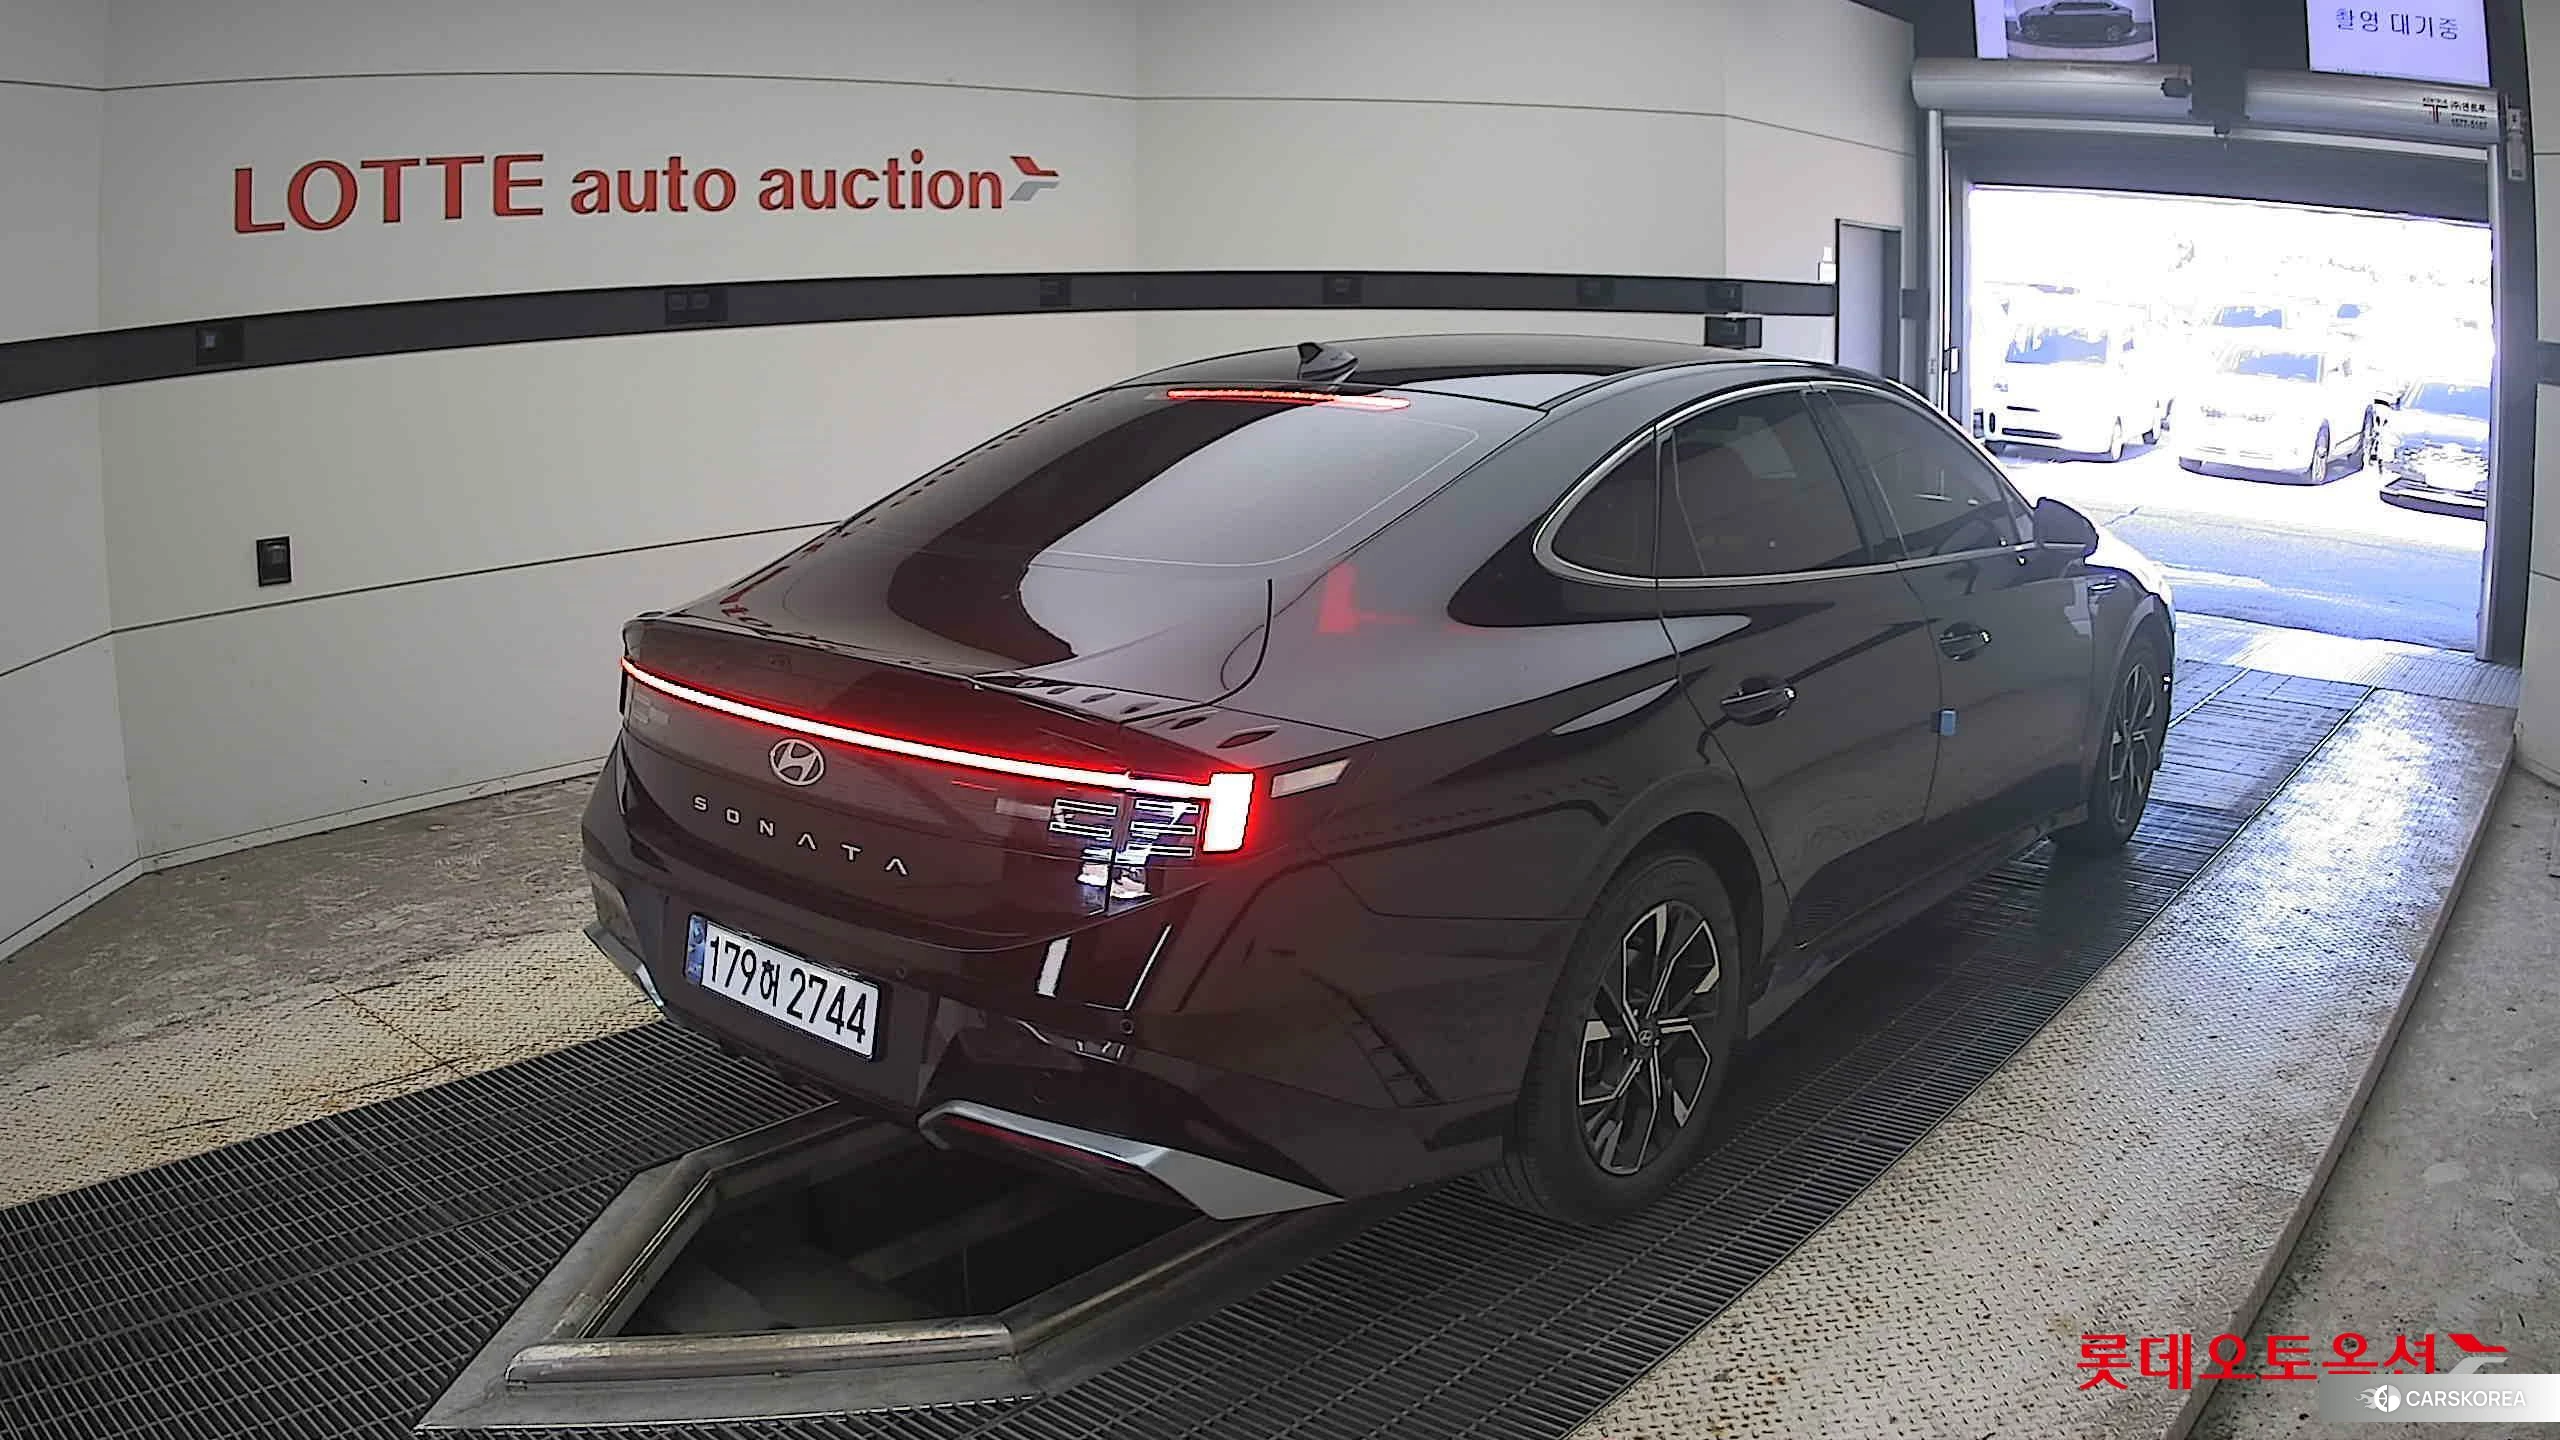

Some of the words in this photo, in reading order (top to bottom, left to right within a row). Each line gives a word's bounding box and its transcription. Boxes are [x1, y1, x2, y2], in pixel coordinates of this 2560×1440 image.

[2390, 12, 2459, 40] 대기중
[234, 153, 544, 234] LOTTE
[570, 155, 736, 215] auto
[758, 148, 1003, 211] auction
[693, 796, 908, 876] SONATA
[710, 935, 781, 1008] 179허
[786, 967, 867, 1044] 2744
